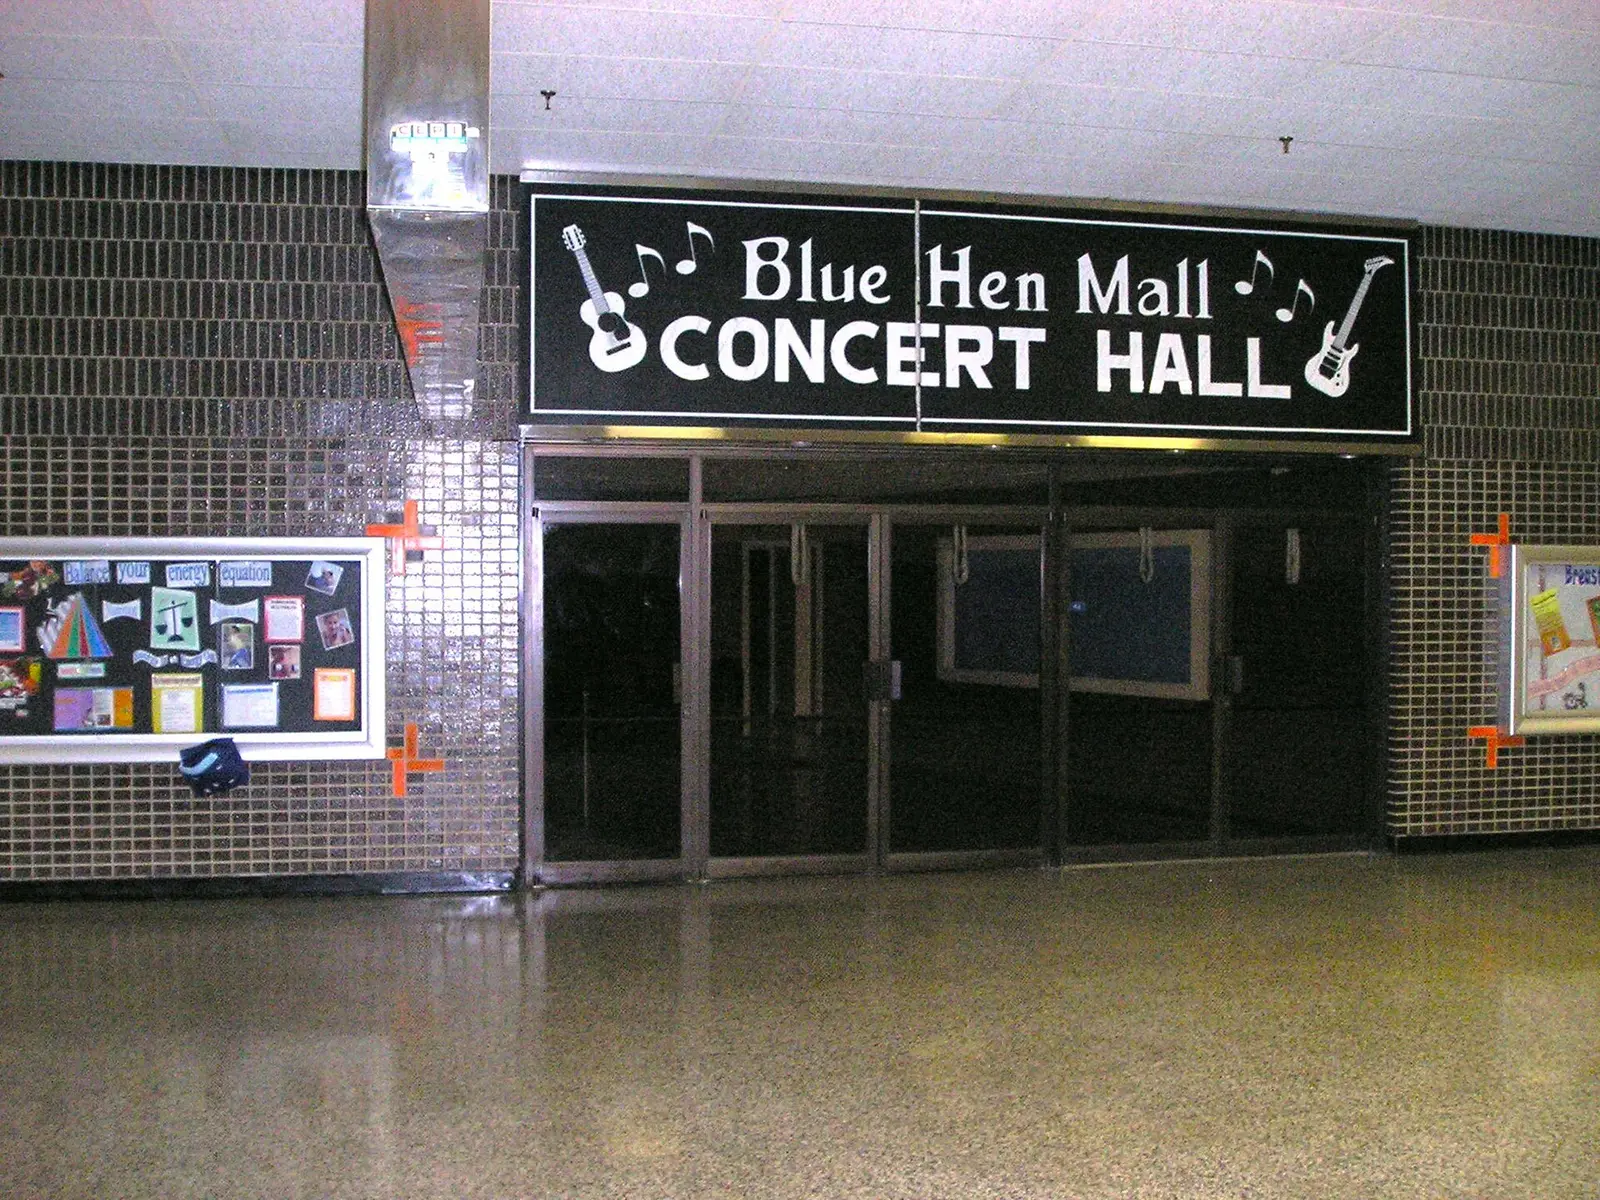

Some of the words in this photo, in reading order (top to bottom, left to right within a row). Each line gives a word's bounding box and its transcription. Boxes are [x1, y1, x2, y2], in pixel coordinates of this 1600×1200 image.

[742, 235, 891, 306] Blue
[924, 245, 1049, 314] Hen
[1074, 252, 1214, 320] Mall
[659, 315, 1047, 391] CONCERT
[1096, 329, 1292, 400] HALL
[65, 562, 110, 583] Balance
[118, 563, 149, 583] your
[167, 565, 208, 586] energy
[221, 565, 271, 586] equation
